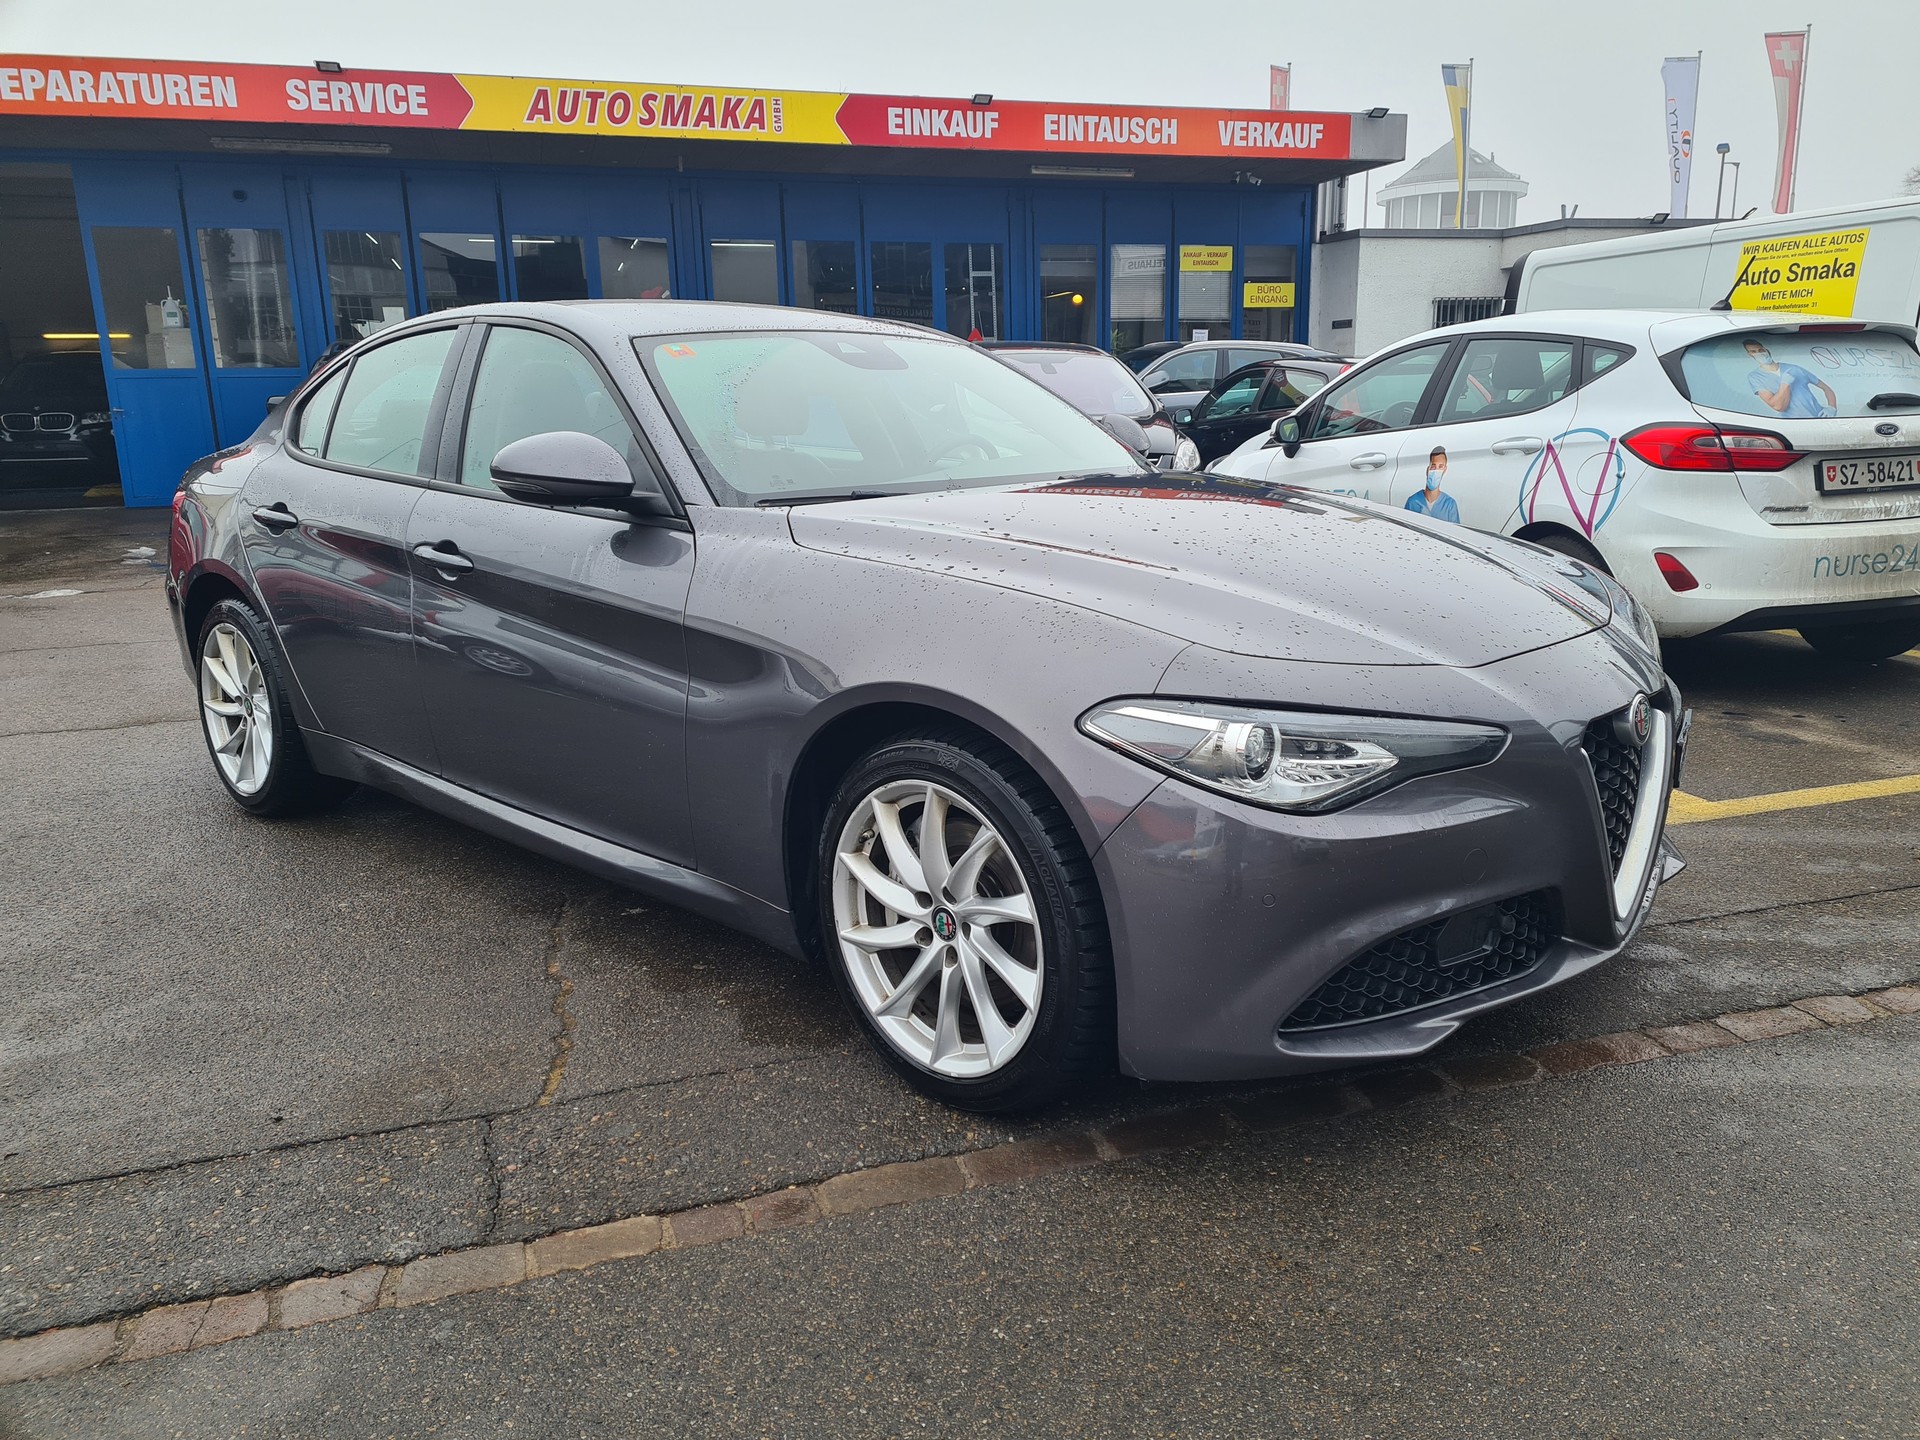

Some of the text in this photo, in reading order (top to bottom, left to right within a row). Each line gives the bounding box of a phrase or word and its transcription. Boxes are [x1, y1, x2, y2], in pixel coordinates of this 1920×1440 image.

[285, 78, 429, 116] SERVICE
[524, 88, 767, 132] AUTO SMAKA
[772, 97, 783, 133] GMBH
[887, 106, 999, 139] EINKAUF
[1044, 113, 1178, 145] EINTAUSCH
[1218, 119, 1324, 150] VERKAUF
[1743, 233, 1865, 255] WIR KAUFEN ALLE AUTOS
[1737, 258, 1856, 287] Auto Smaka
[1250, 295, 1288, 304] EINGANG
[1257, 284, 1281, 294] BÜRO
[1761, 288, 1814, 301] MIETE MICH
[1813, 542, 1920, 578] nurse24
